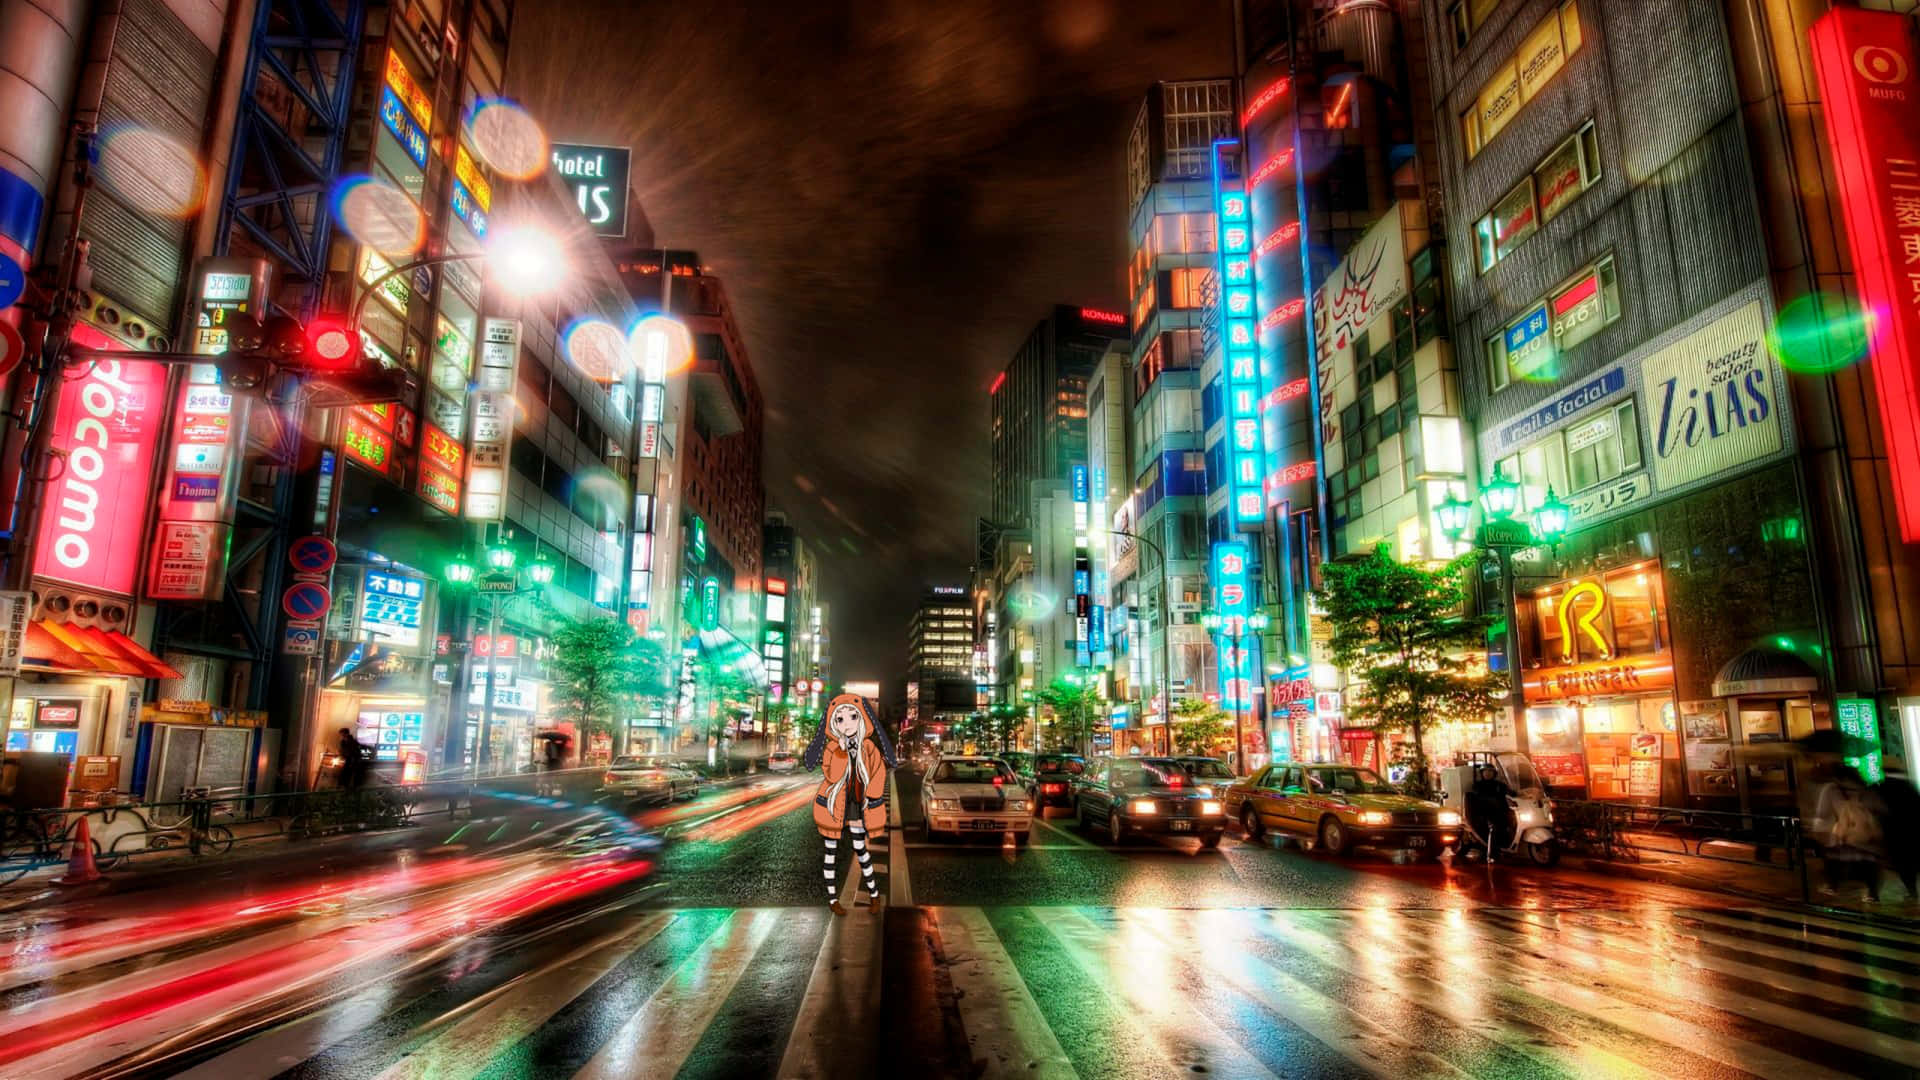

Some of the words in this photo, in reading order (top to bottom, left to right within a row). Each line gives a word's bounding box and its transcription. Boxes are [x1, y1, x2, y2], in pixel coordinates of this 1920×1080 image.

[1869, 87, 1905, 100] MUFG
[552, 152, 604, 177] hotel
[1082, 308, 1124, 324] KONAMI
[1554, 298, 1599, 337] 8461
[1706, 341, 1757, 374] beauty
[1711, 359, 1753, 386] salon
[1544, 413, 1554, 425] &
[1557, 377, 1609, 417] facial
[429, 431, 460, 463] エステ
[55, 359, 132, 569] docomo
[1600, 482, 1636, 509] リラ
[934, 586, 964, 595] FUJIFILM
[1221, 553, 1250, 701] カラオケ館
[1558, 582, 1611, 663] R
[1556, 664, 1642, 693] BURGER
